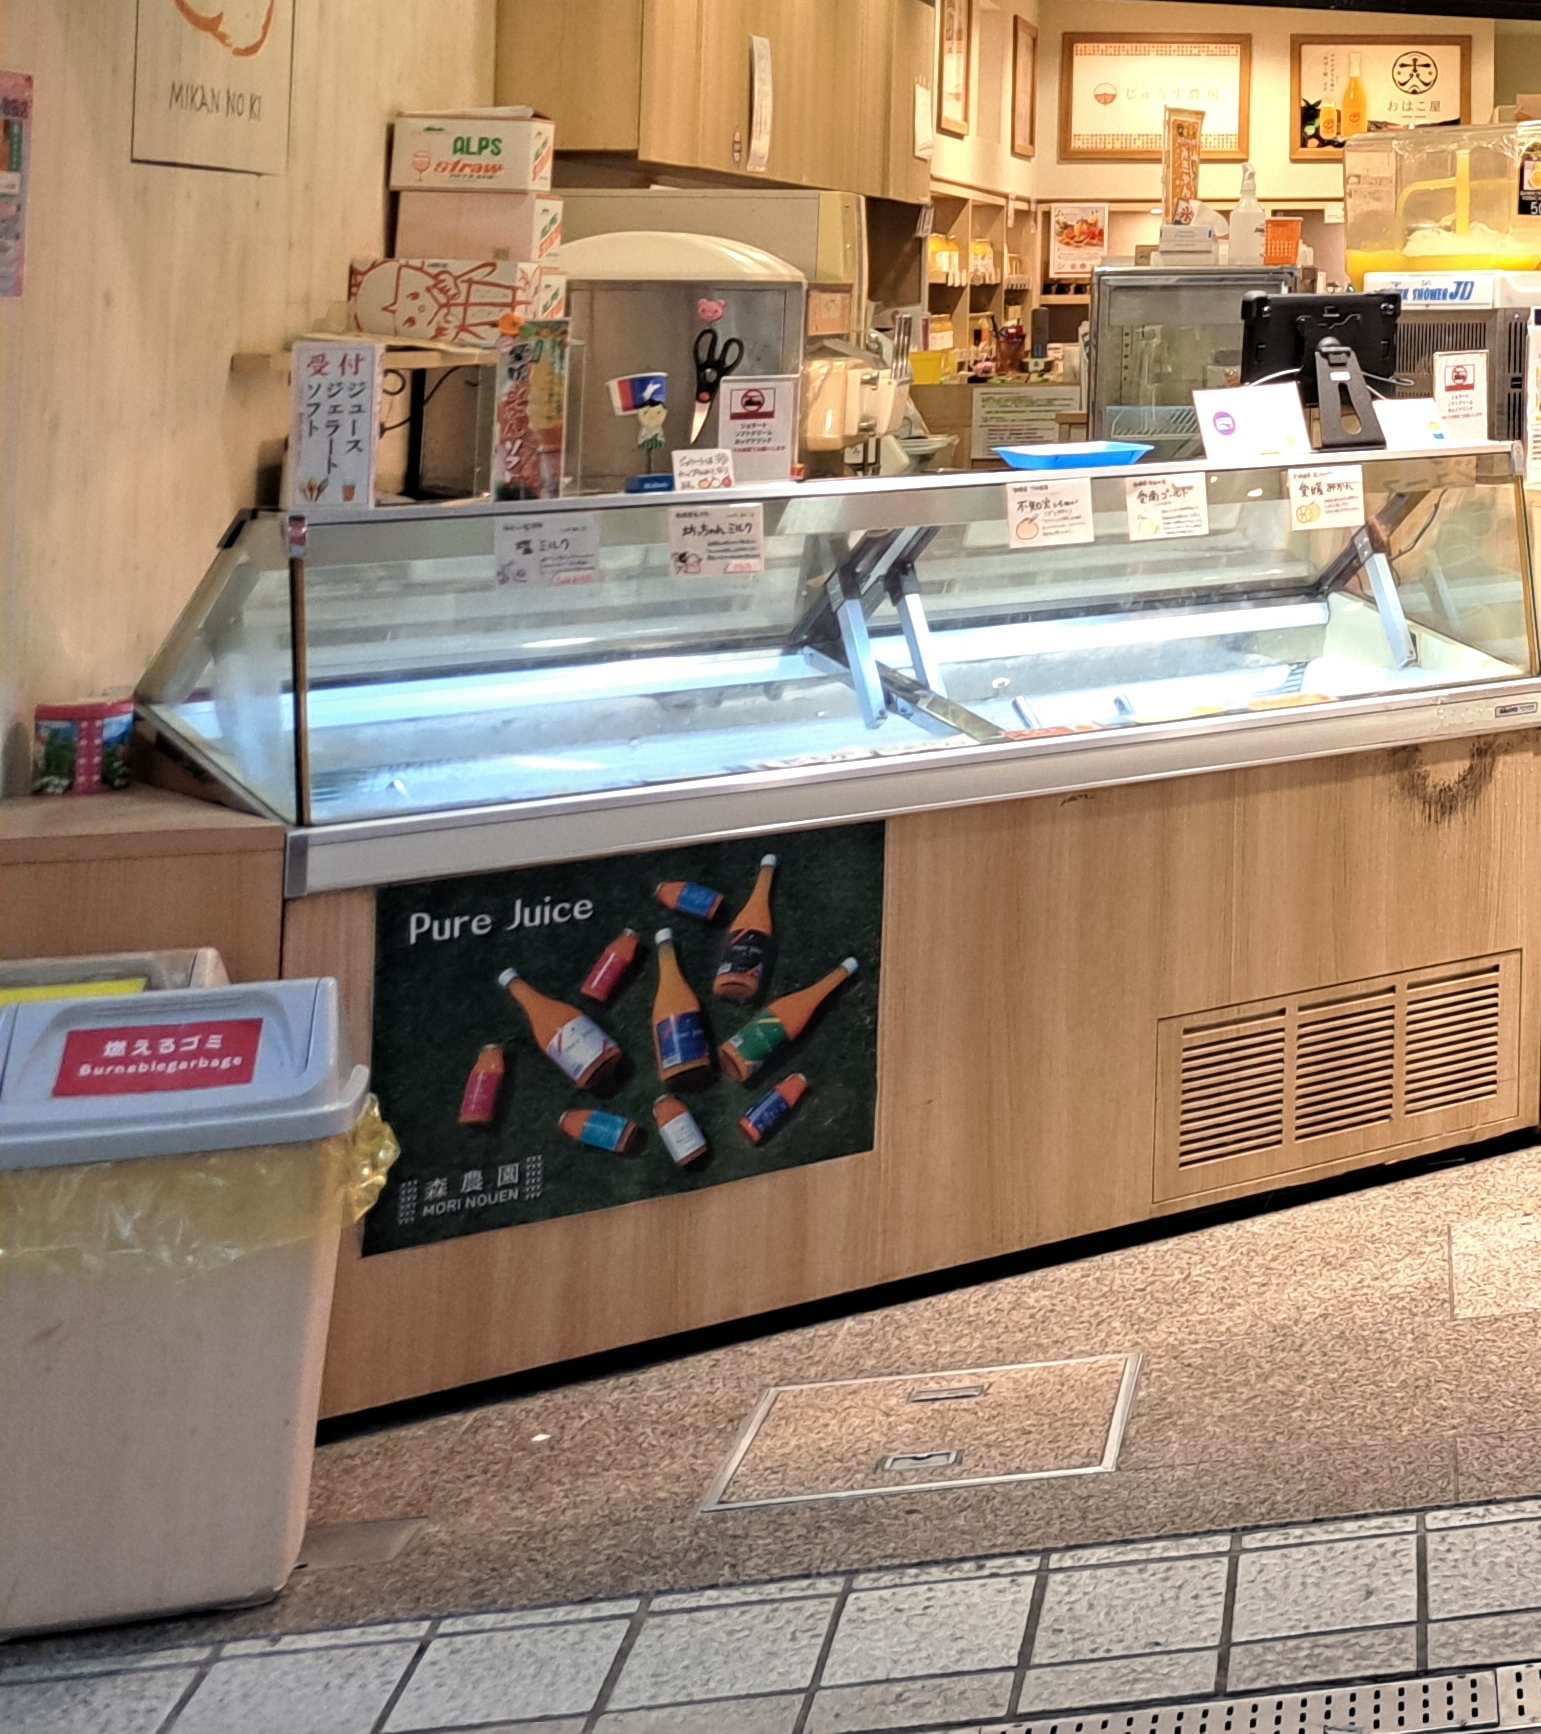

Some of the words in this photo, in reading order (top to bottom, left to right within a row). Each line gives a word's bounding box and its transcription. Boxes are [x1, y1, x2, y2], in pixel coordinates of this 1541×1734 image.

[168, 81, 220, 114] MIKAN
[226, 87, 245, 117] NO
[248, 94, 262, 121] KI
[1387, 100, 1441, 113] おはこ屋
[452, 135, 503, 158] ALPS
[433, 158, 505, 175] straw
[307, 352, 365, 377] 受付
[306, 382, 322, 438] ソフト
[345, 381, 367, 455] ジュース
[325, 381, 344, 475] ジェラート
[1016, 497, 1052, 512] 不知火
[408, 908, 493, 946] Pure
[507, 893, 595, 933] Juice
[102, 1033, 224, 1058] 燃えるゴミ
[77, 1054, 243, 1077] Burnablegarbage
[423, 1162, 520, 1202] 森農園
[422, 1200, 462, 1217] MORI
[464, 1188, 519, 1209] NOUEN
